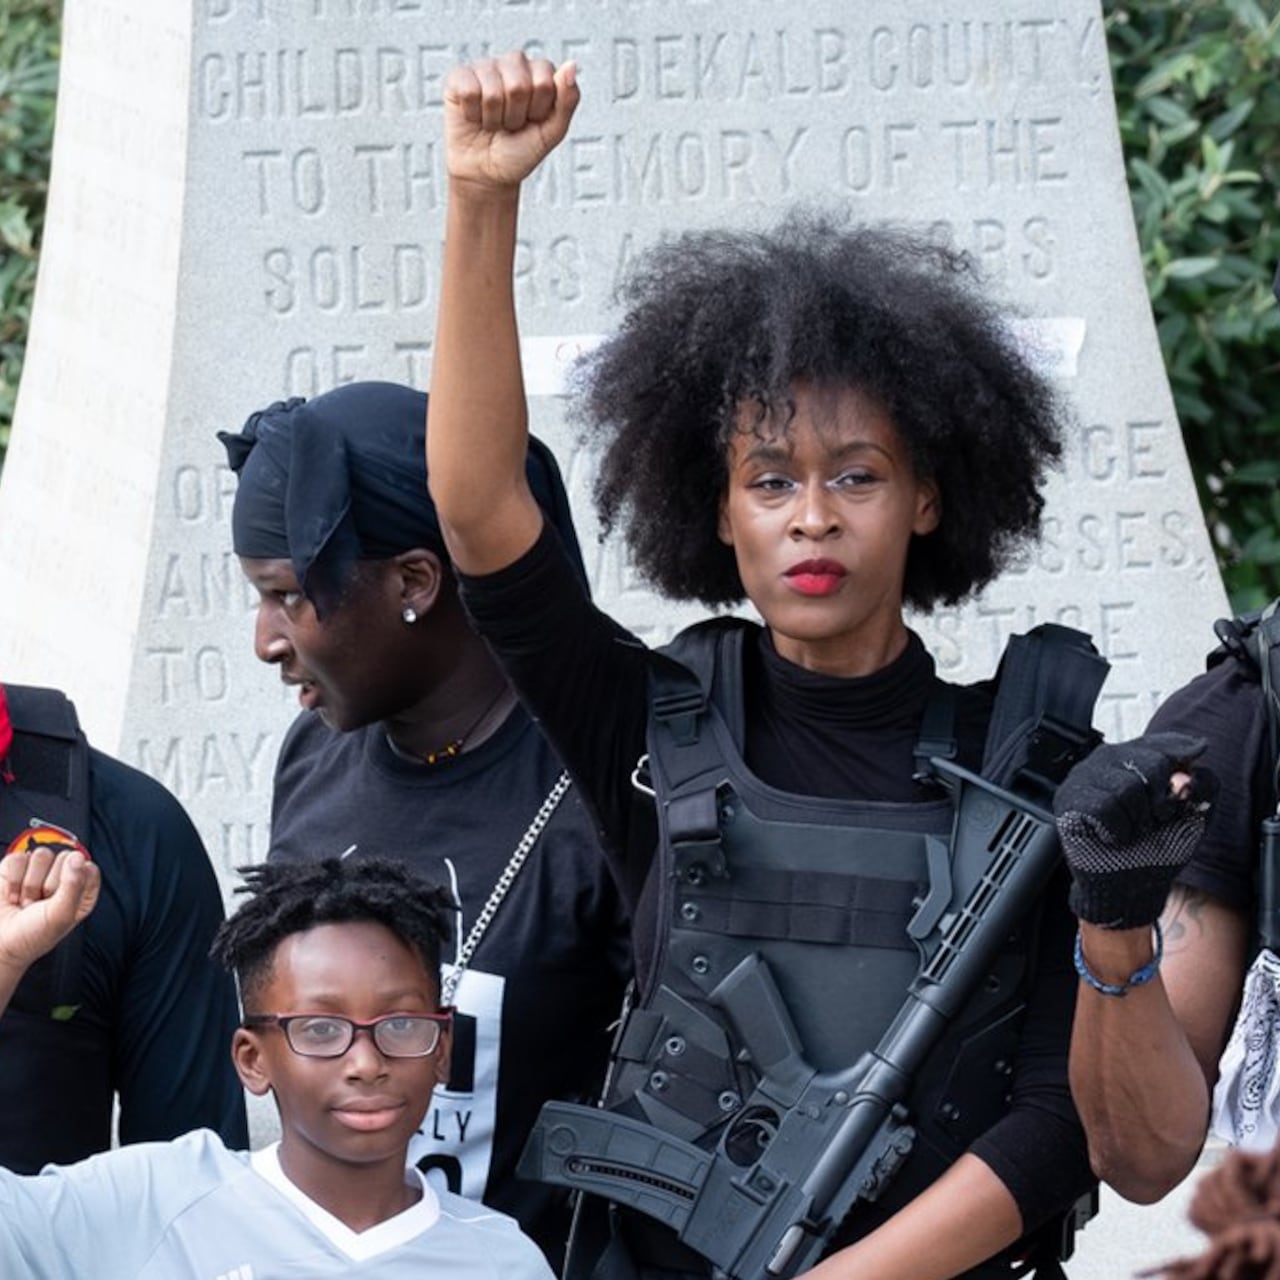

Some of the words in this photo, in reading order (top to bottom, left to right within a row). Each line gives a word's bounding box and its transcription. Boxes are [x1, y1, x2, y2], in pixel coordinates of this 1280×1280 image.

[199, 41, 490, 120] CHILDRE
[611, 27, 846, 102] DEKALB
[867, 16, 1104, 97] COUNTY,
[241, 144, 324, 216] TO
[353, 141, 446, 212] TH
[839, 123, 917, 192] OF
[941, 117, 1069, 191] THE
[147, 645, 228, 706] TO
[137, 732, 266, 801] MAY
